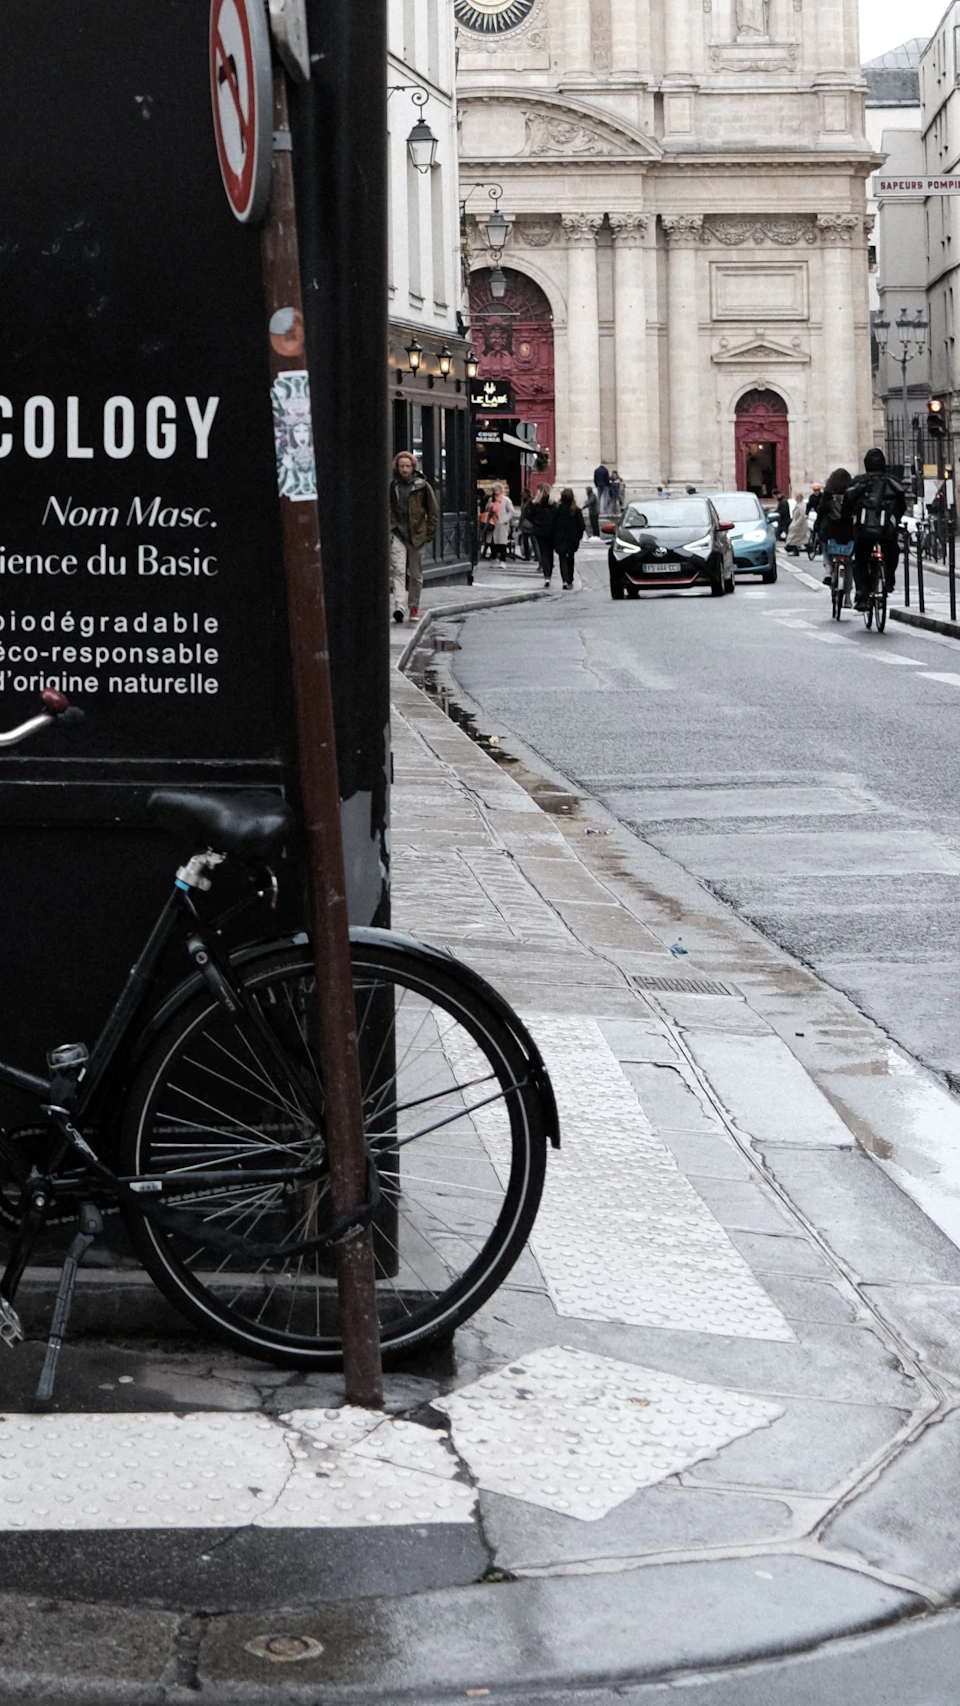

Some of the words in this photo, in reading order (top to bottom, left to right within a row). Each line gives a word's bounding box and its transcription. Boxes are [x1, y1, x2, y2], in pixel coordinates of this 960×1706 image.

[880, 181, 923, 190] SAPEURS
[42, 495, 119, 528] Nom
[126, 496, 217, 528] Masc.
[86, 543, 127, 576] du
[138, 544, 218, 576] Basic
[108, 672, 219, 694] naturelle
